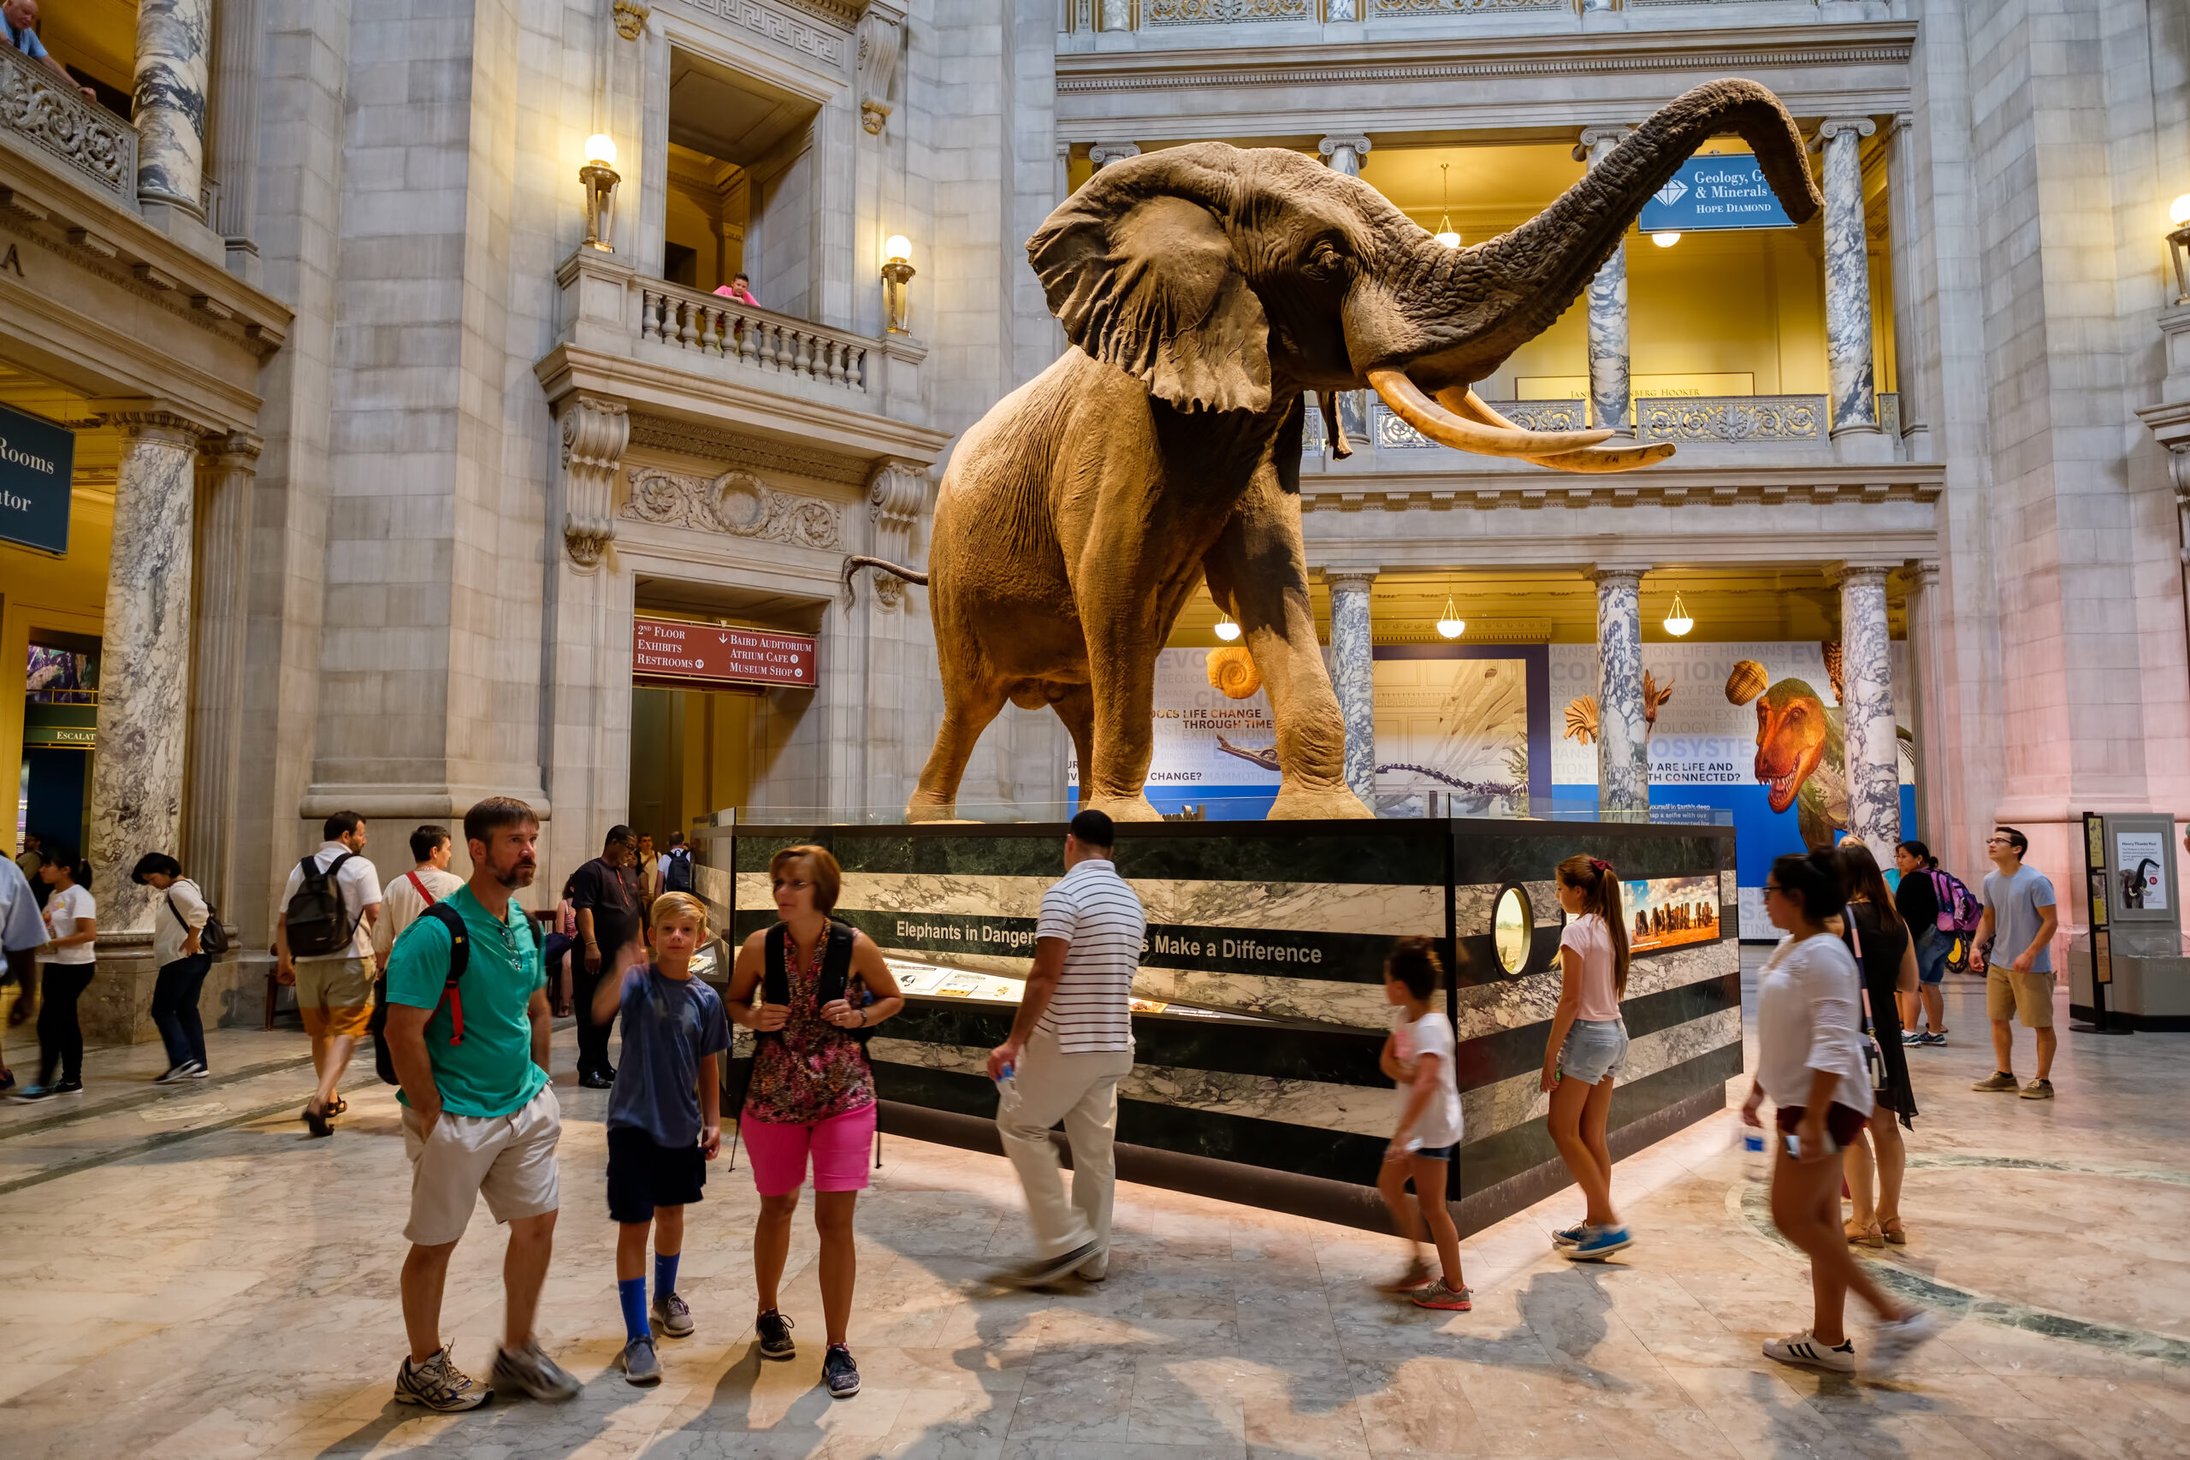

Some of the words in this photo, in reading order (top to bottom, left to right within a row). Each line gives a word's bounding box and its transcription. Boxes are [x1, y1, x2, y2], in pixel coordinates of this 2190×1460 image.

[1694, 171, 1748, 186] Geology,
[1695, 186, 1707, 199] &
[1711, 184, 1767, 198] Minerals
[1696, 204, 1724, 214] HOPE
[1726, 203, 1772, 213] DIAMOND
[1661, 388, 1700, 396] HOOKER
[654, 626, 686, 640] FLOOR
[638, 639, 682, 653] EXHIBITS
[730, 634, 758, 647] BAIRD
[759, 638, 812, 653] AUDITORIUM
[637, 653, 693, 668] RESTROOMS
[730, 648, 764, 661] ATRIUM
[766, 651, 789, 664] CAFE
[729, 662, 768, 676] MUSEUM
[769, 665, 793, 677] SHOP
[1183, 709, 1207, 719] LIFE
[1210, 709, 1261, 719] CHANGE
[1182, 719, 1241, 729] THROUGH
[1656, 762, 1679, 771] ARE
[1682, 762, 1705, 771] LIFE
[1708, 762, 1734, 771] AND
[1150, 772, 1202, 781] CHANGE?
[1665, 772, 1741, 782] CONNECTED?
[896, 920, 961, 942] Elephants
[965, 925, 978, 941] in
[1155, 935, 1200, 956] Make
[1206, 943, 1216, 957] a
[1223, 938, 1322, 963] Difference
